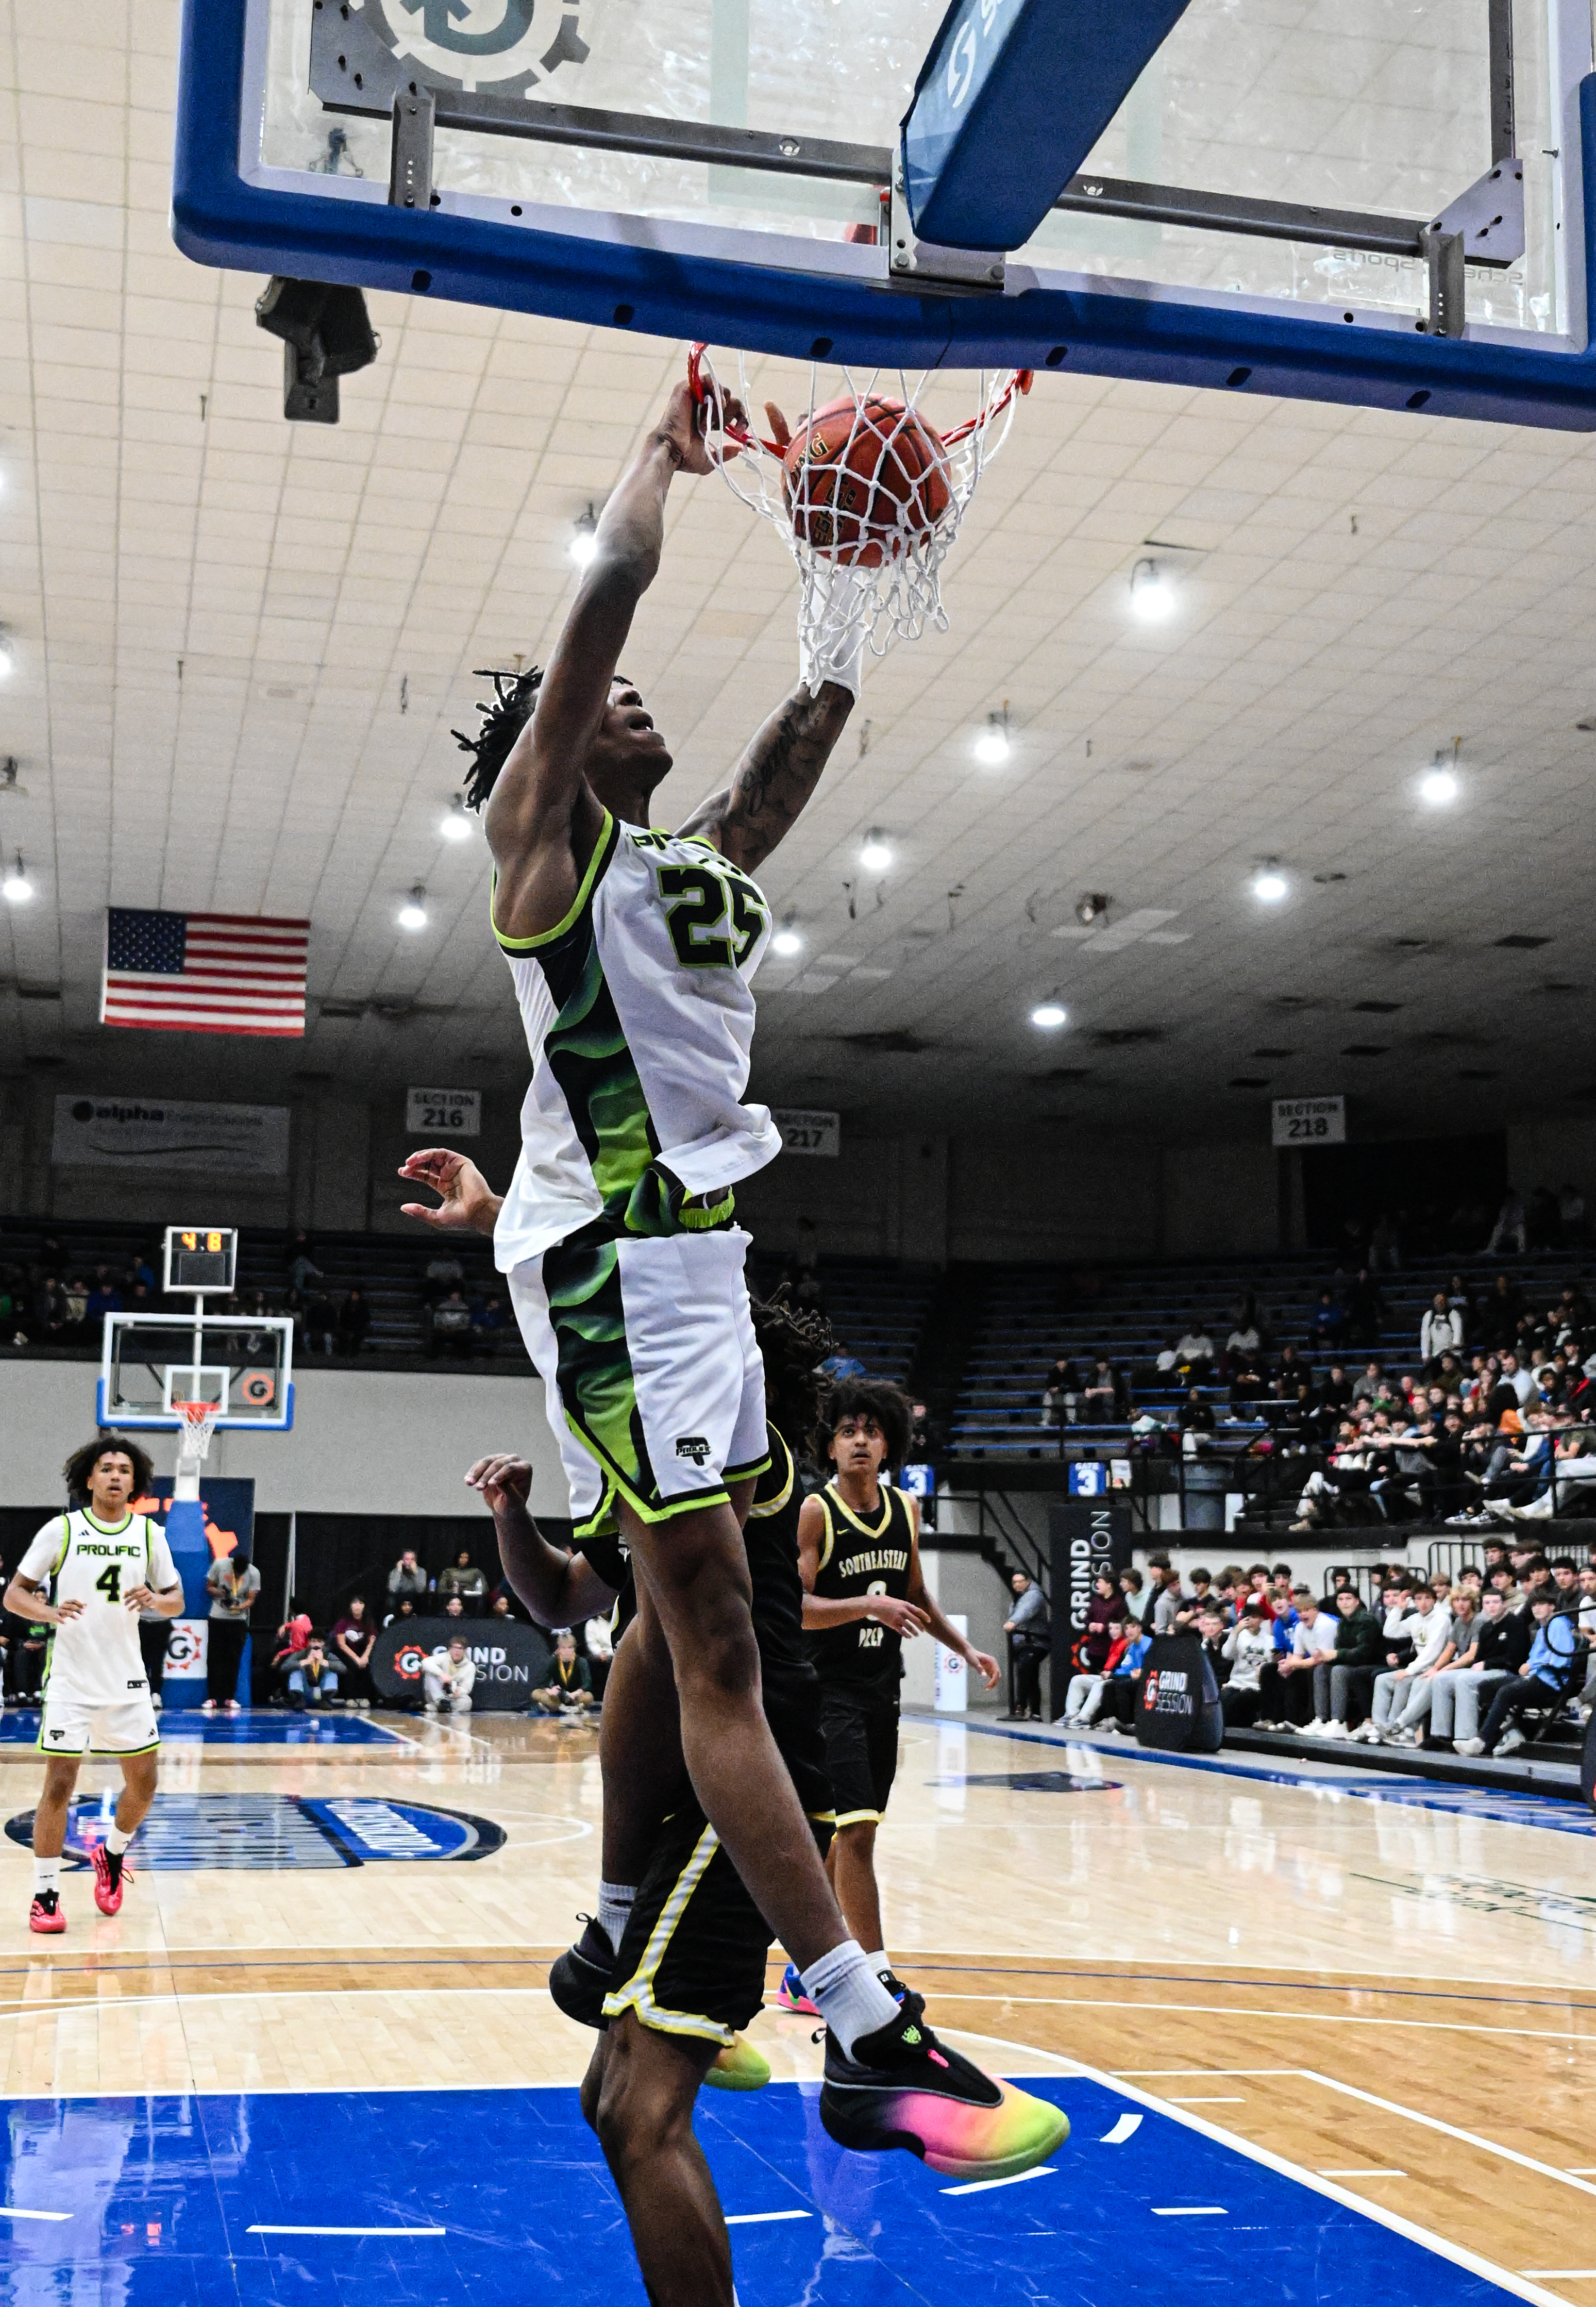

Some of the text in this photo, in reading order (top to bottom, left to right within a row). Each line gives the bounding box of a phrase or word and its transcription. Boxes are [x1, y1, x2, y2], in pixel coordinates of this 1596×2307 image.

[657, 864, 769, 970] 25
[96, 1105, 164, 1123] alpha
[423, 1109, 463, 1127] 216
[787, 1128, 822, 1147] 217
[1289, 1117, 1328, 1137] 218
[908, 1471, 927, 1497] 3
[1077, 1469, 1098, 1496] 3
[77, 1544, 141, 1558] PROLIFIC
[95, 1564, 122, 1603] 4
[1070, 1539, 1091, 1630] GRIND
[1159, 1670, 1188, 1692] GRIND
[1155, 1692, 1193, 1715] SESSION
